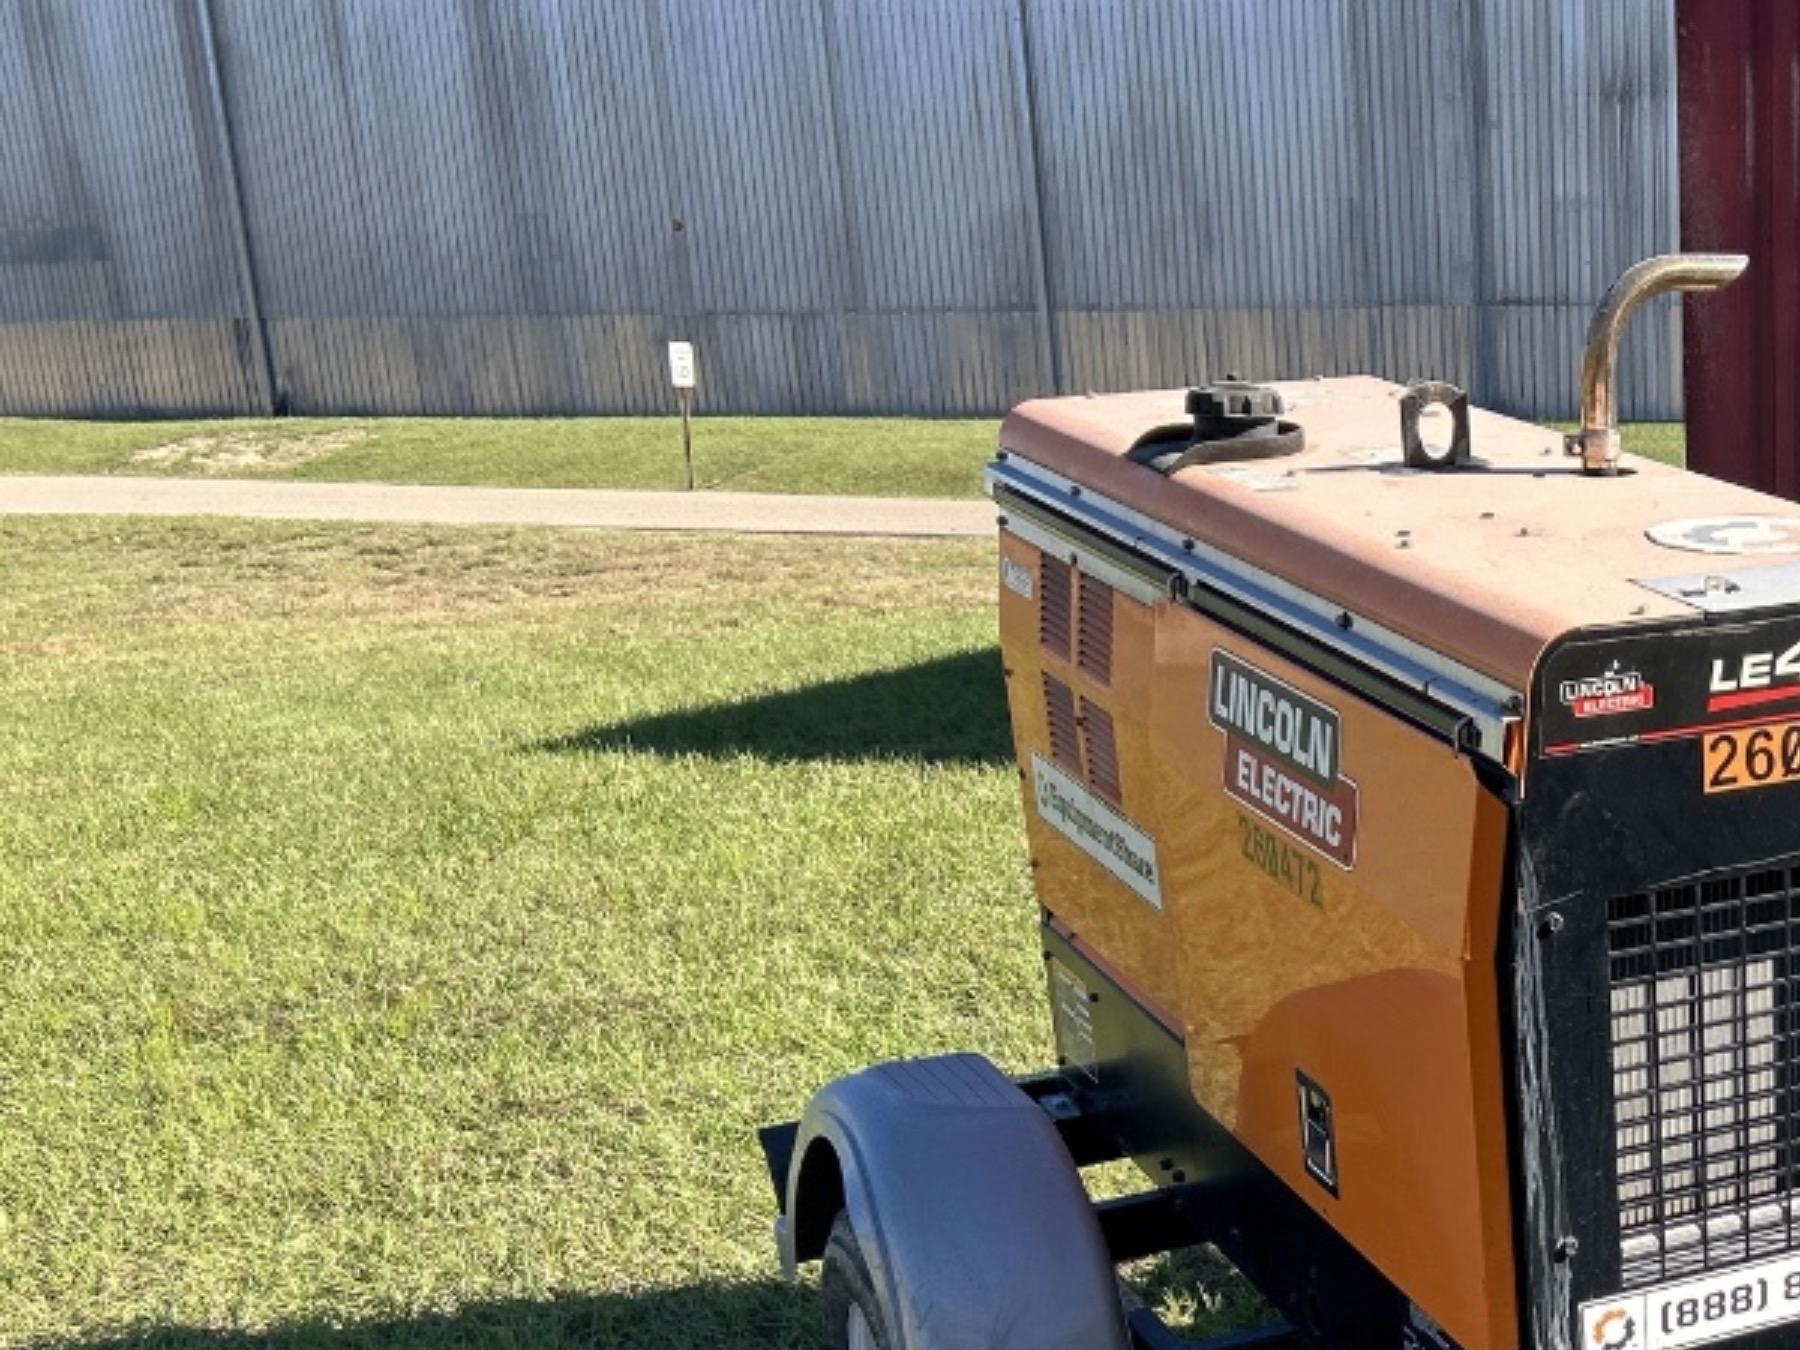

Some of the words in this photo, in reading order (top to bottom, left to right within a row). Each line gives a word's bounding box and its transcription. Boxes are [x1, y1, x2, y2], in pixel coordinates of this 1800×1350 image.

[1214, 664, 1334, 781] LINCOLN
[1237, 748, 1343, 848] ELECTRIC
[1660, 1277, 1768, 1334] (888)
